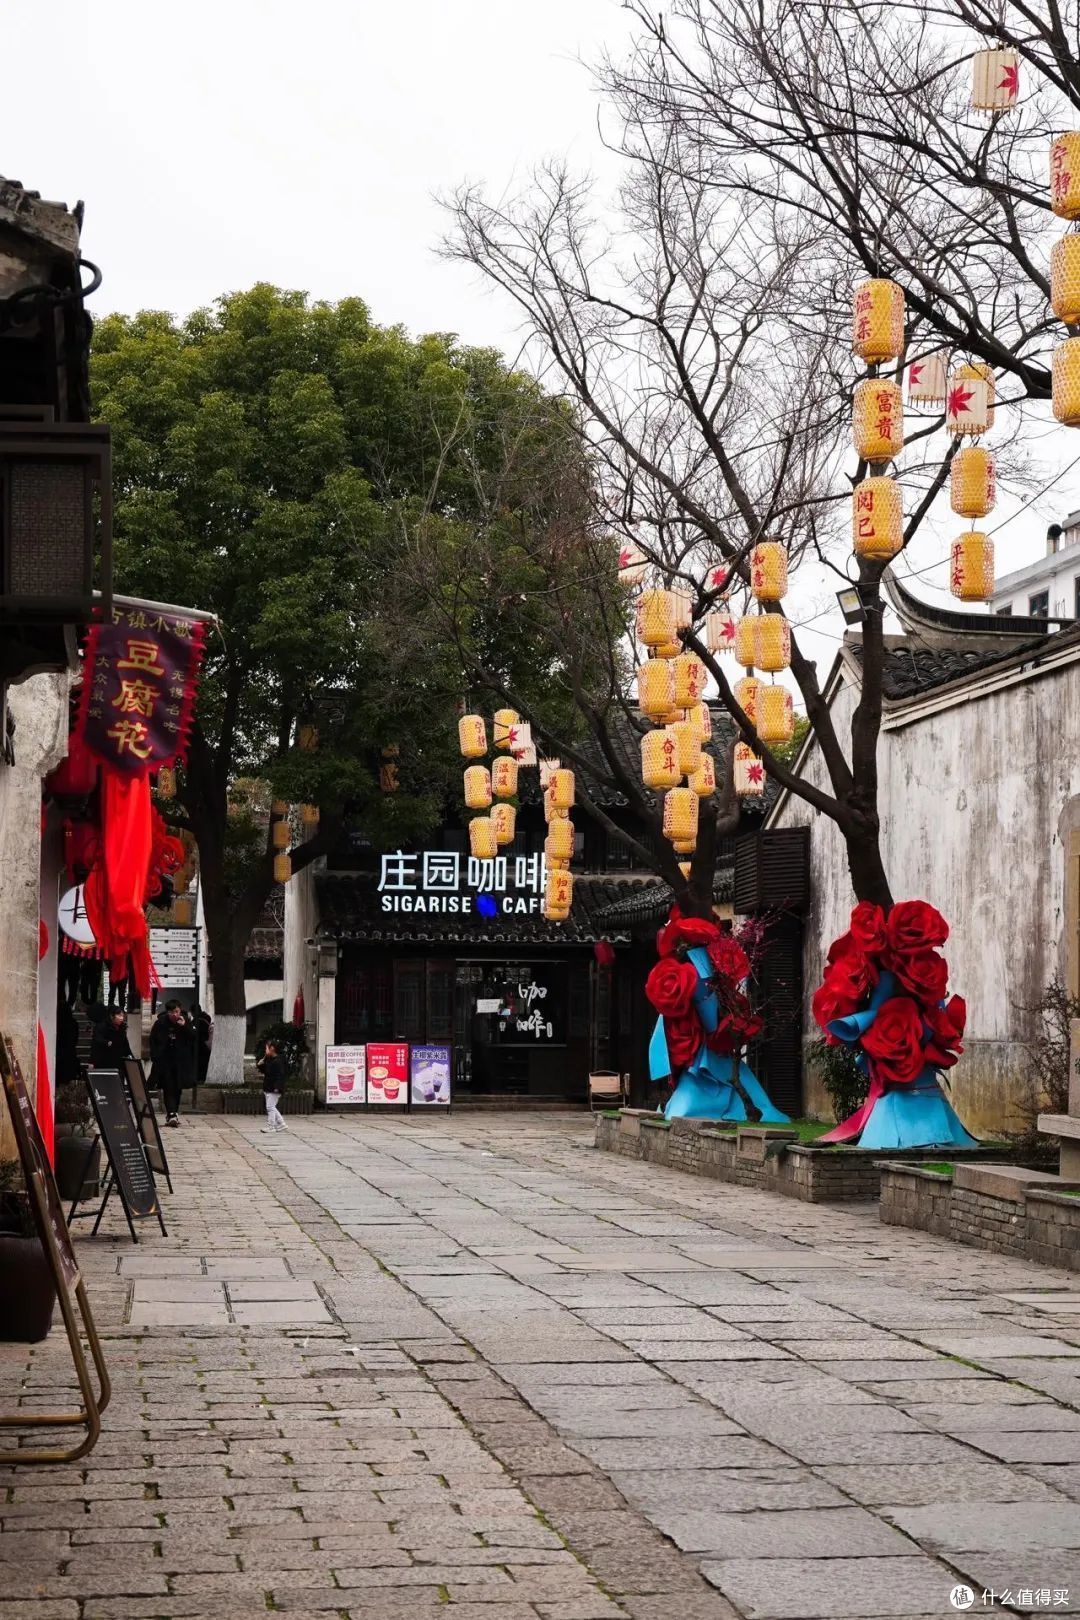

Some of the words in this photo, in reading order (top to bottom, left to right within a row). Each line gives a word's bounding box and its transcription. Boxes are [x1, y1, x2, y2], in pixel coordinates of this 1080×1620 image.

[1051, 146, 1071, 198] 宁静
[856, 291, 873, 340] 温柔
[875, 389, 895, 441] 富贵
[752, 553, 765, 587] 如意
[951, 543, 965, 587] 平安
[107, 639, 165, 760] 豆腐花
[686, 663, 699, 698] 得意
[662, 738, 675, 774] 奋斗
[702, 759, 714, 786] 幸福
[377, 849, 548, 893] 庄园咖啡
[556, 877, 568, 903] 归真
[381, 895, 471, 913] SIGARISE
